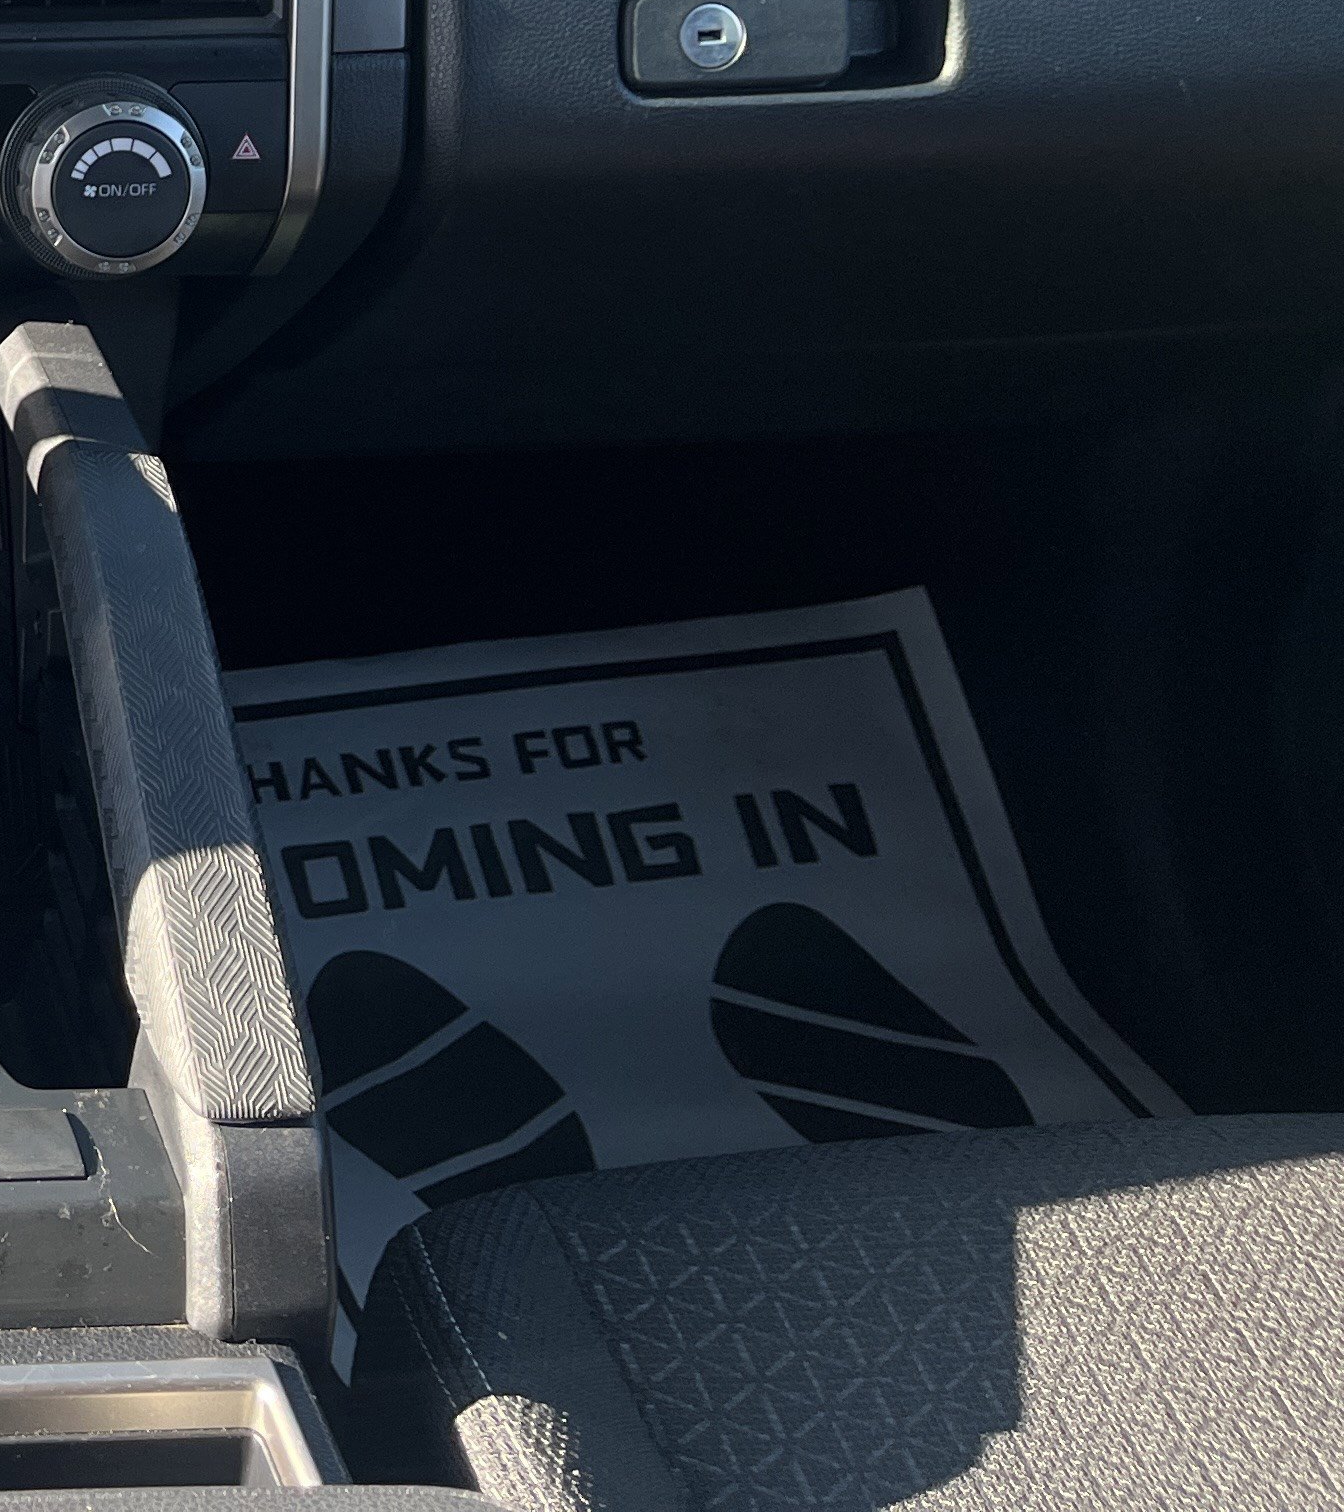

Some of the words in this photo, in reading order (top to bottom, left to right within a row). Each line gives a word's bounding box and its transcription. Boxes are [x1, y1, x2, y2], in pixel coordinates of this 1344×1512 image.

[98, 182, 157, 198] ON/OFF
[247, 736, 493, 805] HANKS
[512, 720, 648, 775] FOR
[281, 801, 703, 920] OMING
[733, 782, 880, 870] IN
